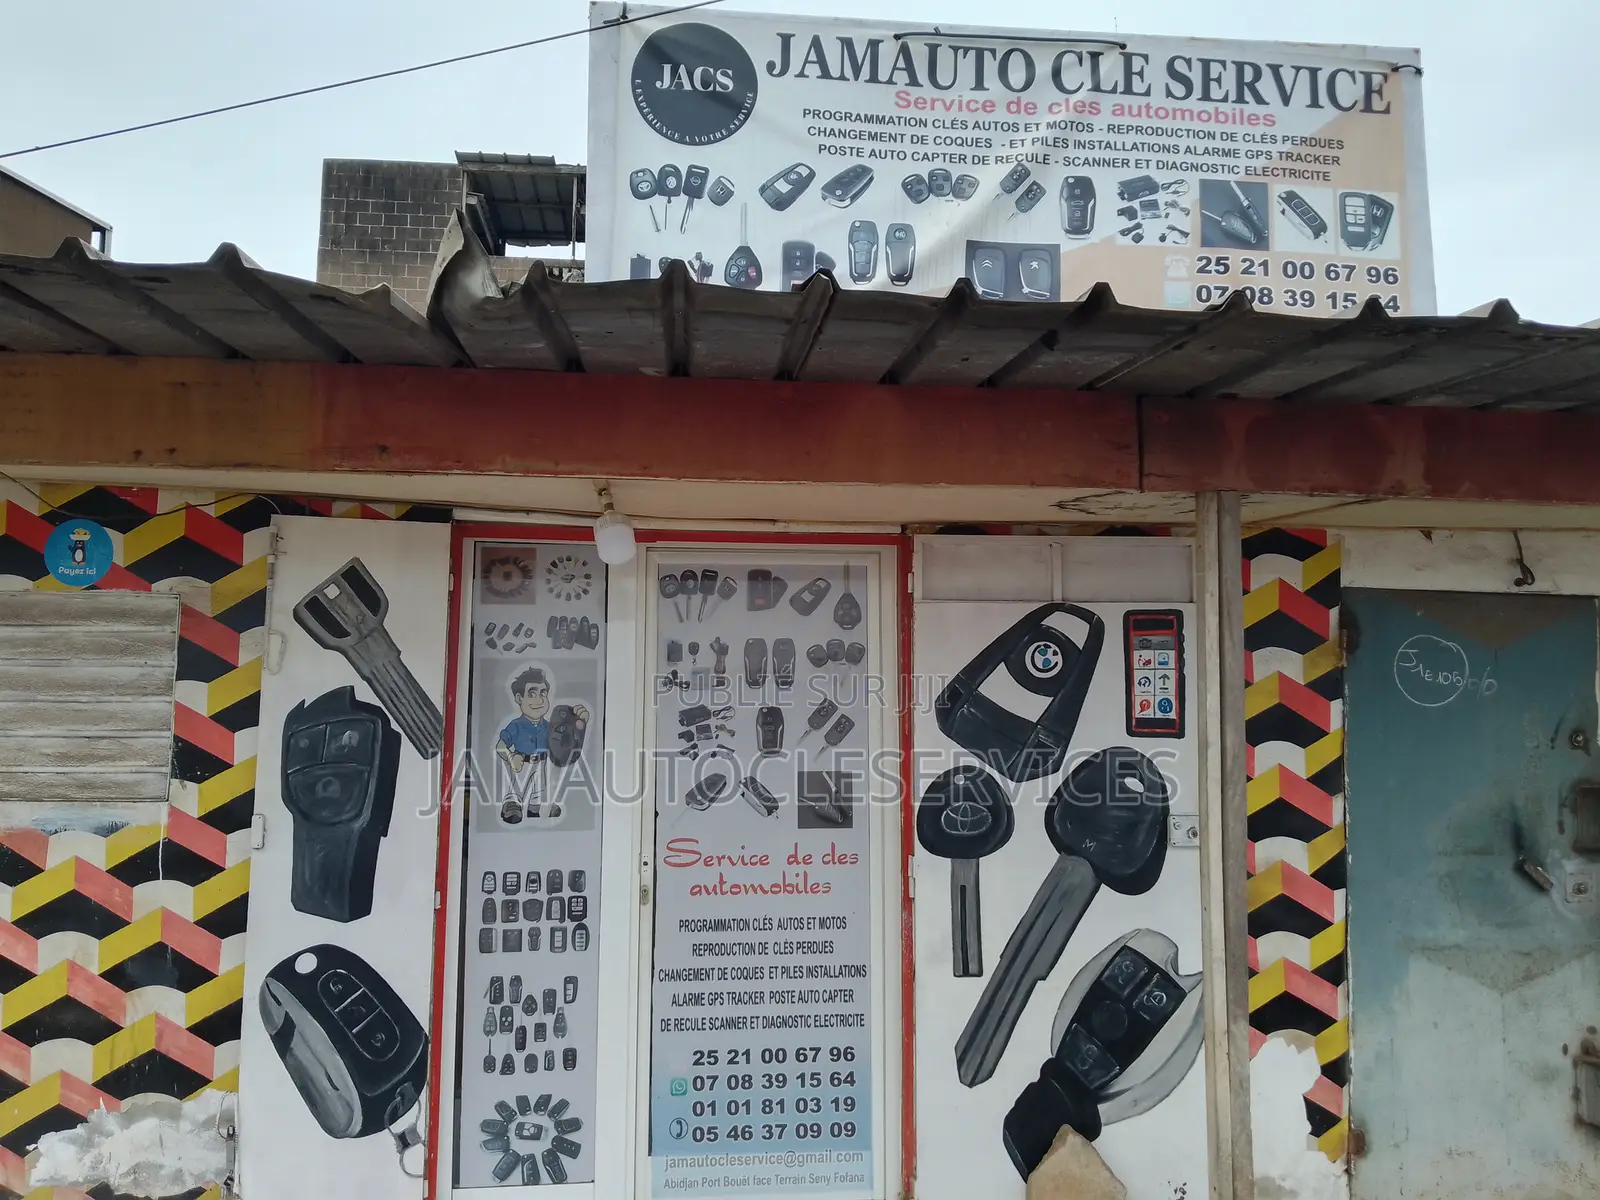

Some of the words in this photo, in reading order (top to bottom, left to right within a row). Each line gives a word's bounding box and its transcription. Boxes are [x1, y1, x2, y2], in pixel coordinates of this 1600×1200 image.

[655, 63, 734, 93] JACS
[766, 32, 1036, 93] JAMAUTO
[1051, 50, 1152, 97] CLE
[1165, 54, 1391, 115] SERVICE
[694, 128, 729, 143] VOTRE
[729, 91, 754, 130] SERVICE
[894, 90, 996, 113] Service
[1006, 96, 1038, 116] de
[1048, 98, 1102, 116] cles
[1111, 101, 1277, 127] automobiles
[803, 108, 928, 129] PROGRAMMATION
[932, 117, 969, 131] CLÉS
[972, 120, 1020, 133] AUTOS
[1024, 122, 1042, 133] ET
[1046, 120, 1095, 133] MOTOS
[1107, 123, 1217, 141] REPRODUCTION
[1220, 131, 1238, 142] DE
[1242, 132, 1278, 145] CLÉS
[1282, 135, 1344, 150] PERDUES
[807, 126, 906, 144] CHANGEMENT
[910, 134, 929, 146] DE
[933, 135, 993, 149] COQUES
[1009, 138, 1028, 149] ET
[1031, 136, 1069, 149] PILES
[1073, 139, 1184, 155] INSTALLATIONS
[1183, 145, 1241, 159] ALARME
[1244, 149, 1273, 161] GPS
[1276, 151, 1341, 166] TRACKER
[818, 143, 865, 158] POSTE
[868, 148, 907, 161] AUTO
[911, 151, 968, 165] CAPTER
[971, 154, 991, 165] DE
[994, 152, 1051, 165] RECULE
[1062, 156, 1134, 169] SCANNER
[1135, 159, 1152, 170] ET
[1155, 159, 1241, 175] DIAGNOSTIC
[1244, 165, 1332, 182] ELECTRICITE
[1195, 255, 1231, 275] 25
[1239, 257, 1270, 277] 21
[1282, 260, 1315, 280] 00
[1324, 262, 1357, 282] 67
[1366, 265, 1399, 285] 96
[1196, 284, 1229, 303] 07
[1283, 288, 1316, 309] 39
[1325, 291, 1357, 310] 15
[1367, 293, 1401, 313] 4
[58, 566, 85, 576] Payez
[86, 567, 97, 575] ici
[663, 837, 770, 868] Service
[786, 842, 814, 866] de
[821, 841, 859, 866] cles
[689, 870, 832, 897] automobiles
[678, 917, 750, 933] PROGRAMMATION
[752, 914, 773, 931] CLÉS
[777, 916, 805, 931] AUTOS
[806, 916, 817, 930] ET
[818, 915, 847, 930] MOTOS
[692, 942, 756, 957] REPRODUCTION
[757, 941, 769, 955] DE
[773, 938, 794, 955] CLÉS
[795, 940, 834, 955] PERDUES
[658, 967, 715, 983] CHANGEMENT
[717, 967, 729, 981] DE
[730, 966, 765, 981] COQUES
[768, 966, 780, 980] ET
[780, 965, 804, 980] PILES
[805, 964, 867, 979] INSTALLATIONS
[671, 992, 705, 1007] ALARME
[707, 992, 725, 1006] GPS
[726, 990, 765, 1006] TRACKER
[769, 990, 796, 1005] POSTE
[797, 989, 820, 1004] AUTO
[822, 989, 855, 1004] CAPTER
[660, 1018, 672, 1032] DE
[673, 1017, 707, 1032] RECULE
[708, 1016, 748, 1031] SCANNER
[749, 1015, 760, 1030] ET
[762, 1014, 812, 1029] DIAGNOSTIC
[813, 1013, 865, 1029] ELECTRICITE
[692, 1049, 719, 1066] 25
[726, 1049, 752, 1065] 21
[760, 1048, 788, 1064] 00
[794, 1046, 822, 1063] 67
[828, 1046, 856, 1062] 96
[692, 1074, 719, 1092] 07
[726, 1074, 753, 1091] 08
[760, 1073, 788, 1089] 39
[795, 1071, 822, 1088] 15
[829, 1070, 856, 1087] 64
[692, 1100, 717, 1117] 01
[726, 1099, 752, 1116] 01
[760, 1097, 786, 1114] 81
[794, 1096, 822, 1114] 03
[829, 1096, 856, 1112] 19
[691, 1125, 720, 1143] 05
[726, 1125, 754, 1142] 46
[760, 1123, 788, 1140] 37
[794, 1122, 822, 1139] 09
[829, 1121, 856, 1138] 09
[664, 1149, 864, 1173] jamautocleservice@gmail.com
[663, 1176, 699, 1192] Abidjan
[701, 1175, 721, 1188] Port
[752, 1173, 772, 1186] face
[774, 1173, 807, 1186] Terrain
[808, 1171, 831, 1187] Seny
[833, 1171, 865, 1184] Fofana
